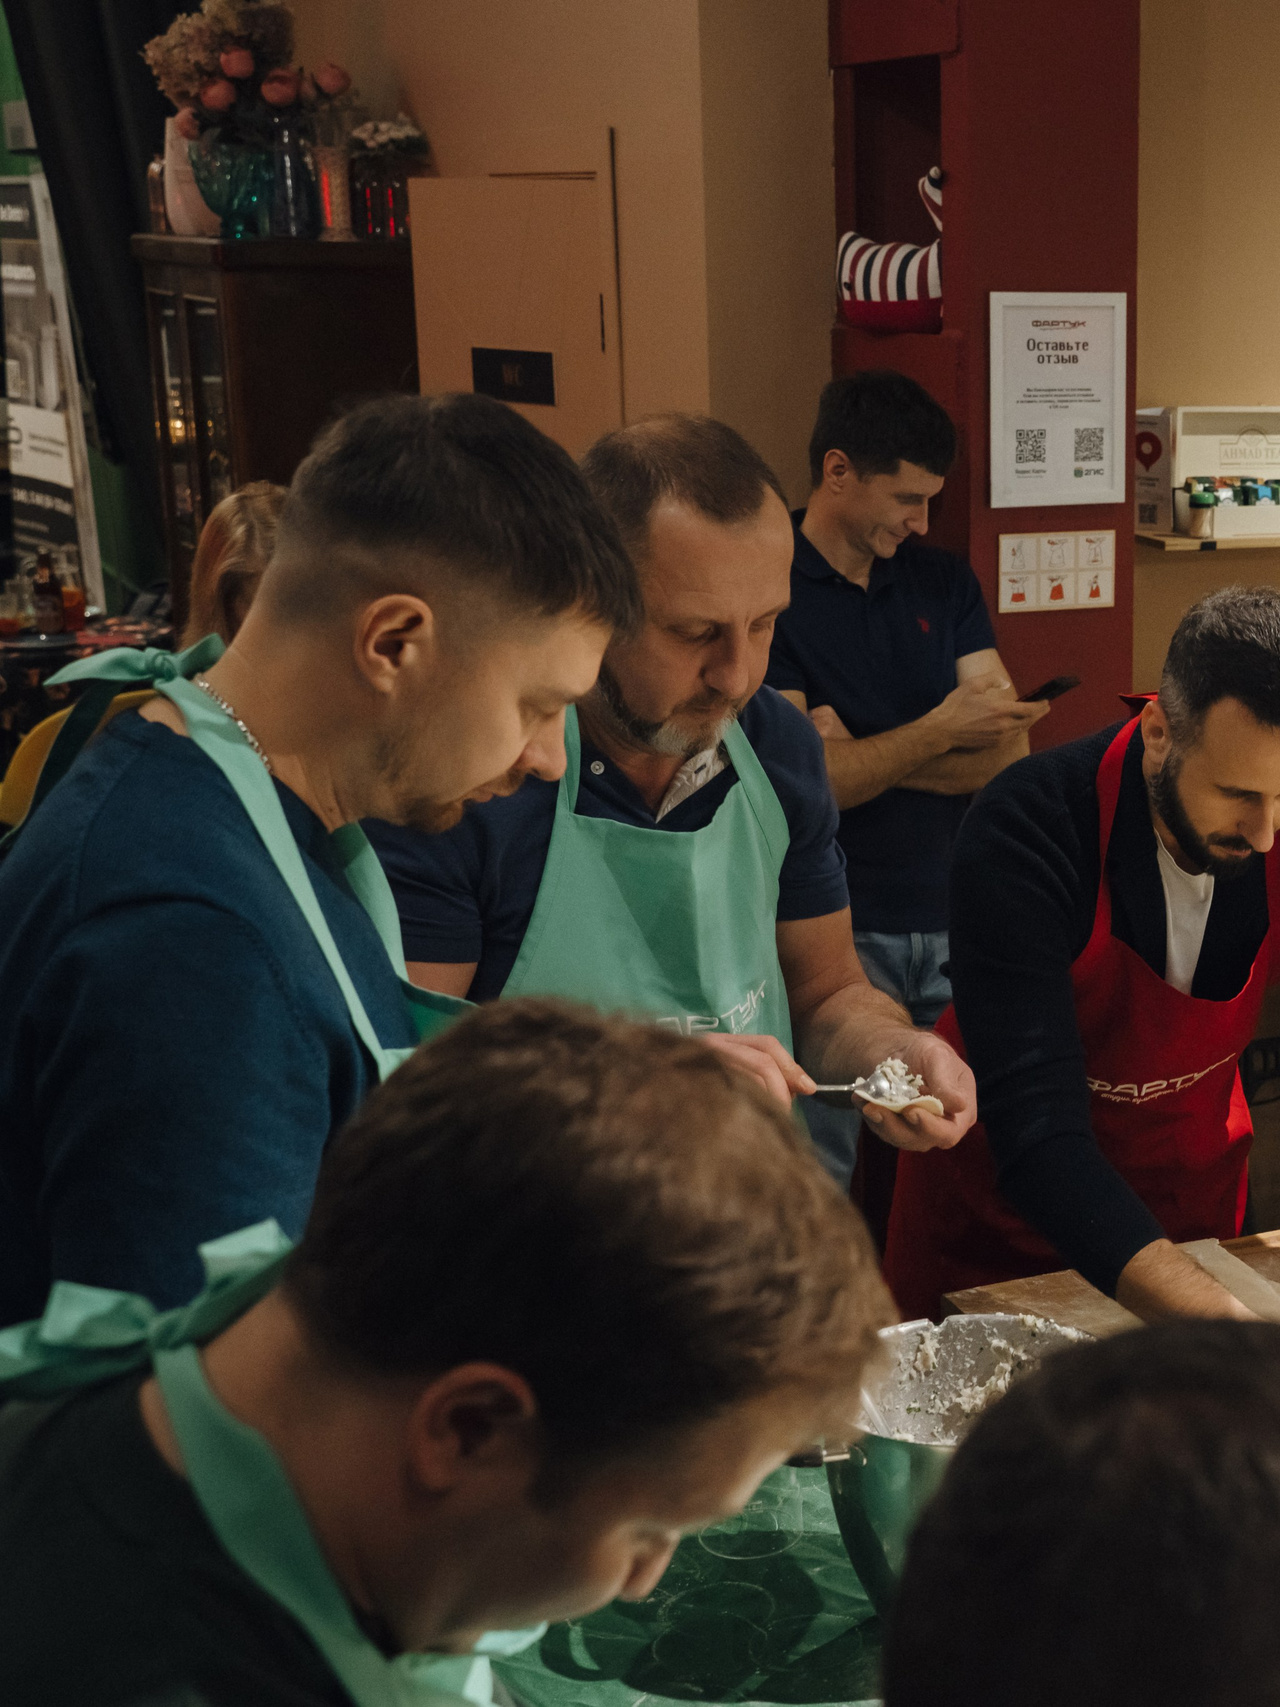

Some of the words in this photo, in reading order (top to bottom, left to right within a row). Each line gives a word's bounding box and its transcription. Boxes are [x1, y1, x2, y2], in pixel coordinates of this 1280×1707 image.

[1026, 338, 1089, 351] Оставьте
[1037, 354, 1079, 364] отзыв
[1222, 447, 1262, 460] AHMAD
